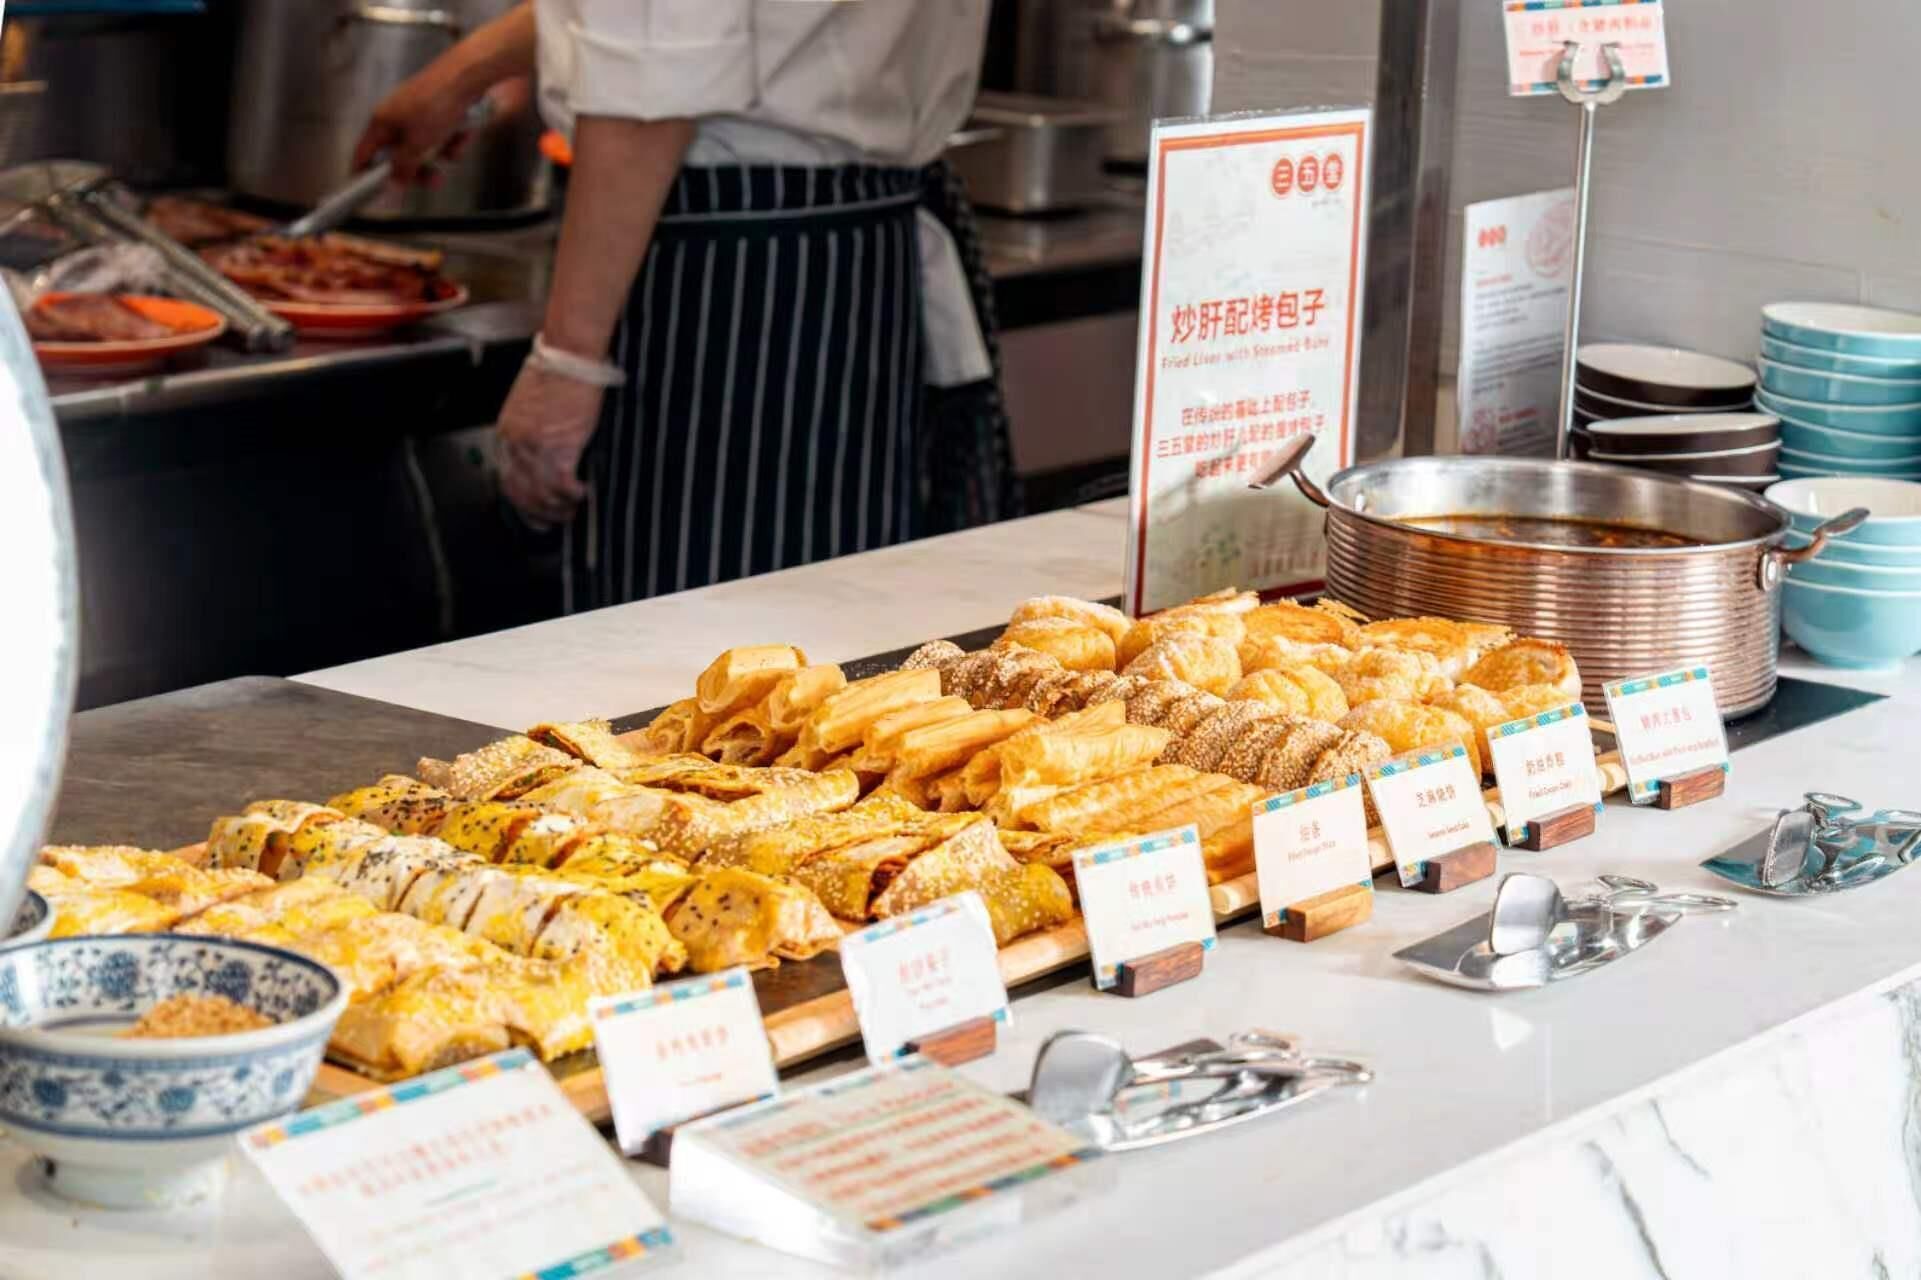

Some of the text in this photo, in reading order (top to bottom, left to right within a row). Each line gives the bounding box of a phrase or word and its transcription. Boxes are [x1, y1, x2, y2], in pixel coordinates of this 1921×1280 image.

[1170, 288, 1325, 343] 炒肝配烤包子
[1161, 353, 1189, 369] Fried
[1226, 347, 1249, 361] with
